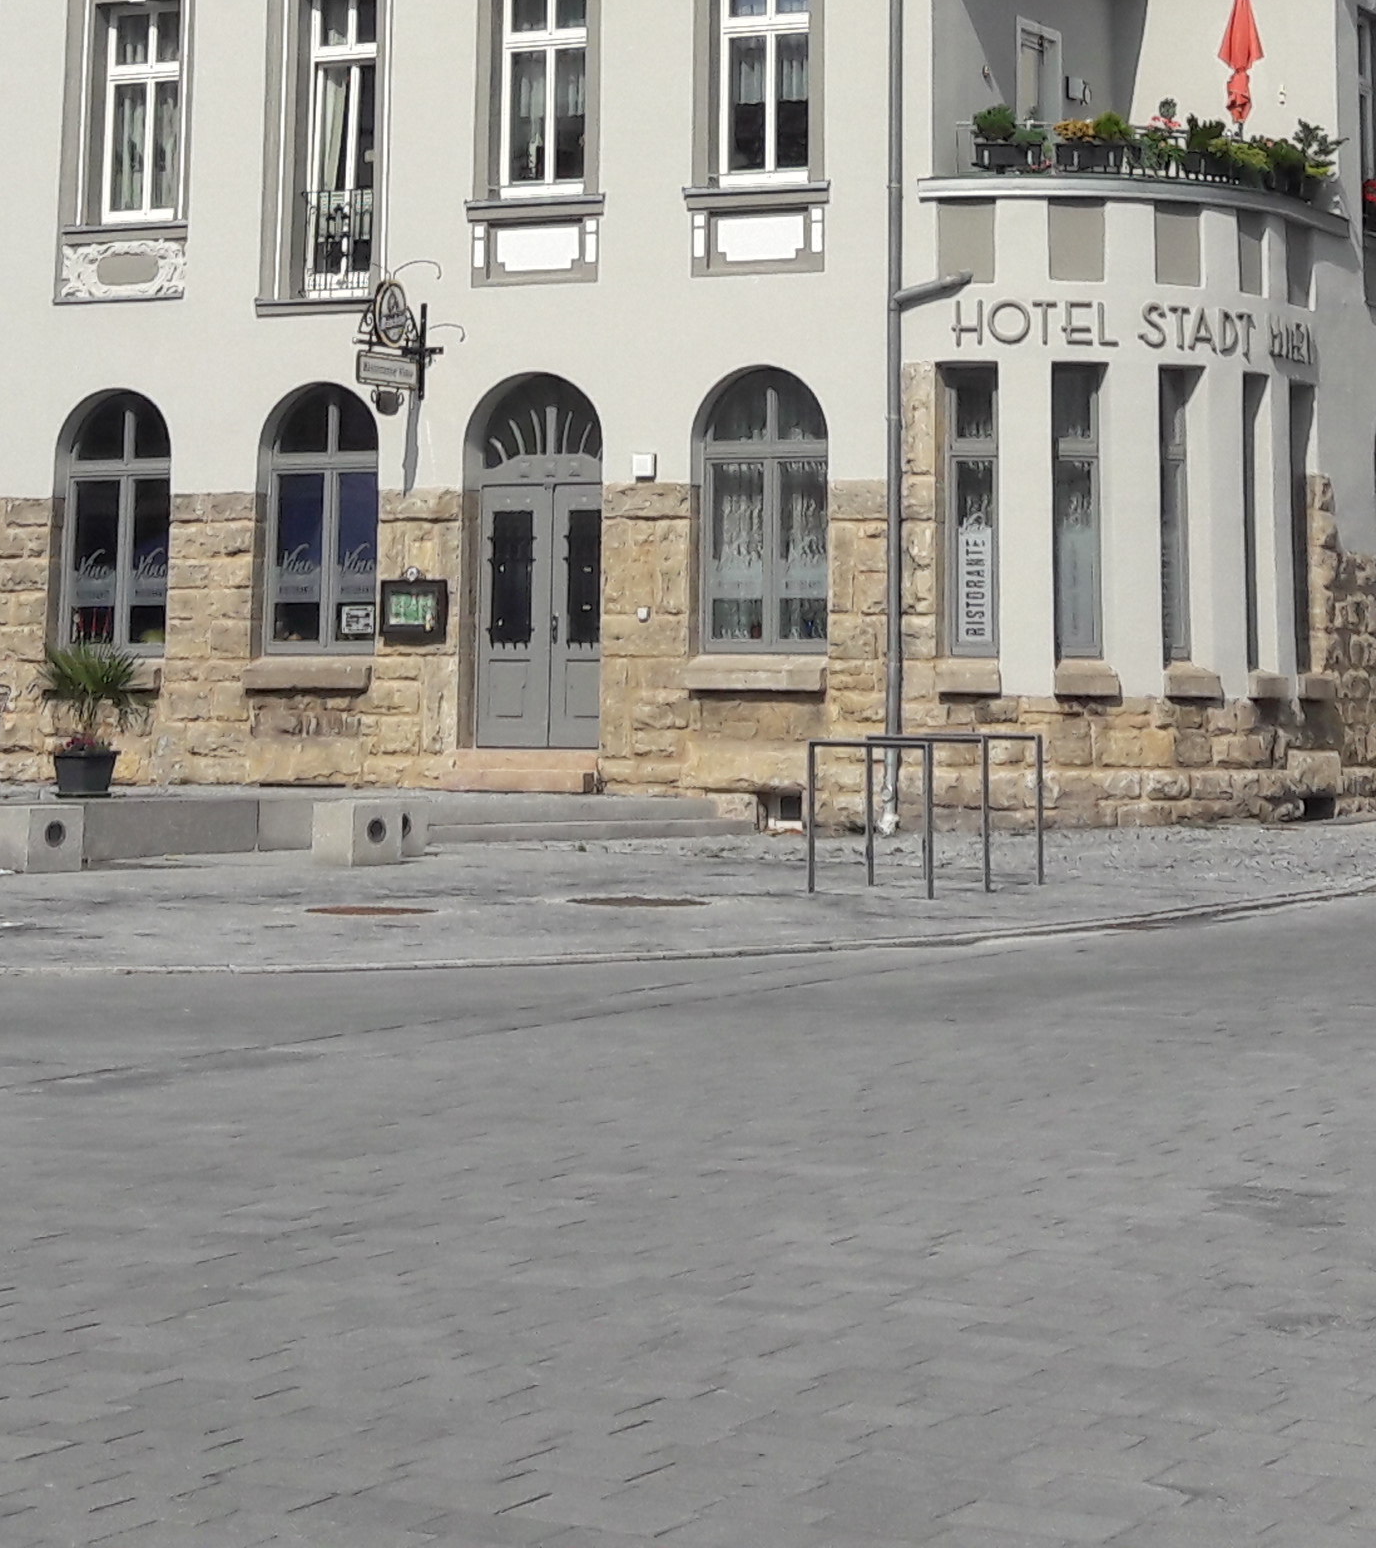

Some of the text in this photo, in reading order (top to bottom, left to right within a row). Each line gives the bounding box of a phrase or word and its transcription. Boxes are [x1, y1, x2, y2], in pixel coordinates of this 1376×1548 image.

[951, 299, 1119, 347] HOTEL
[1136, 302, 1257, 364] STADT
[965, 539, 985, 637] RISTORANTE
